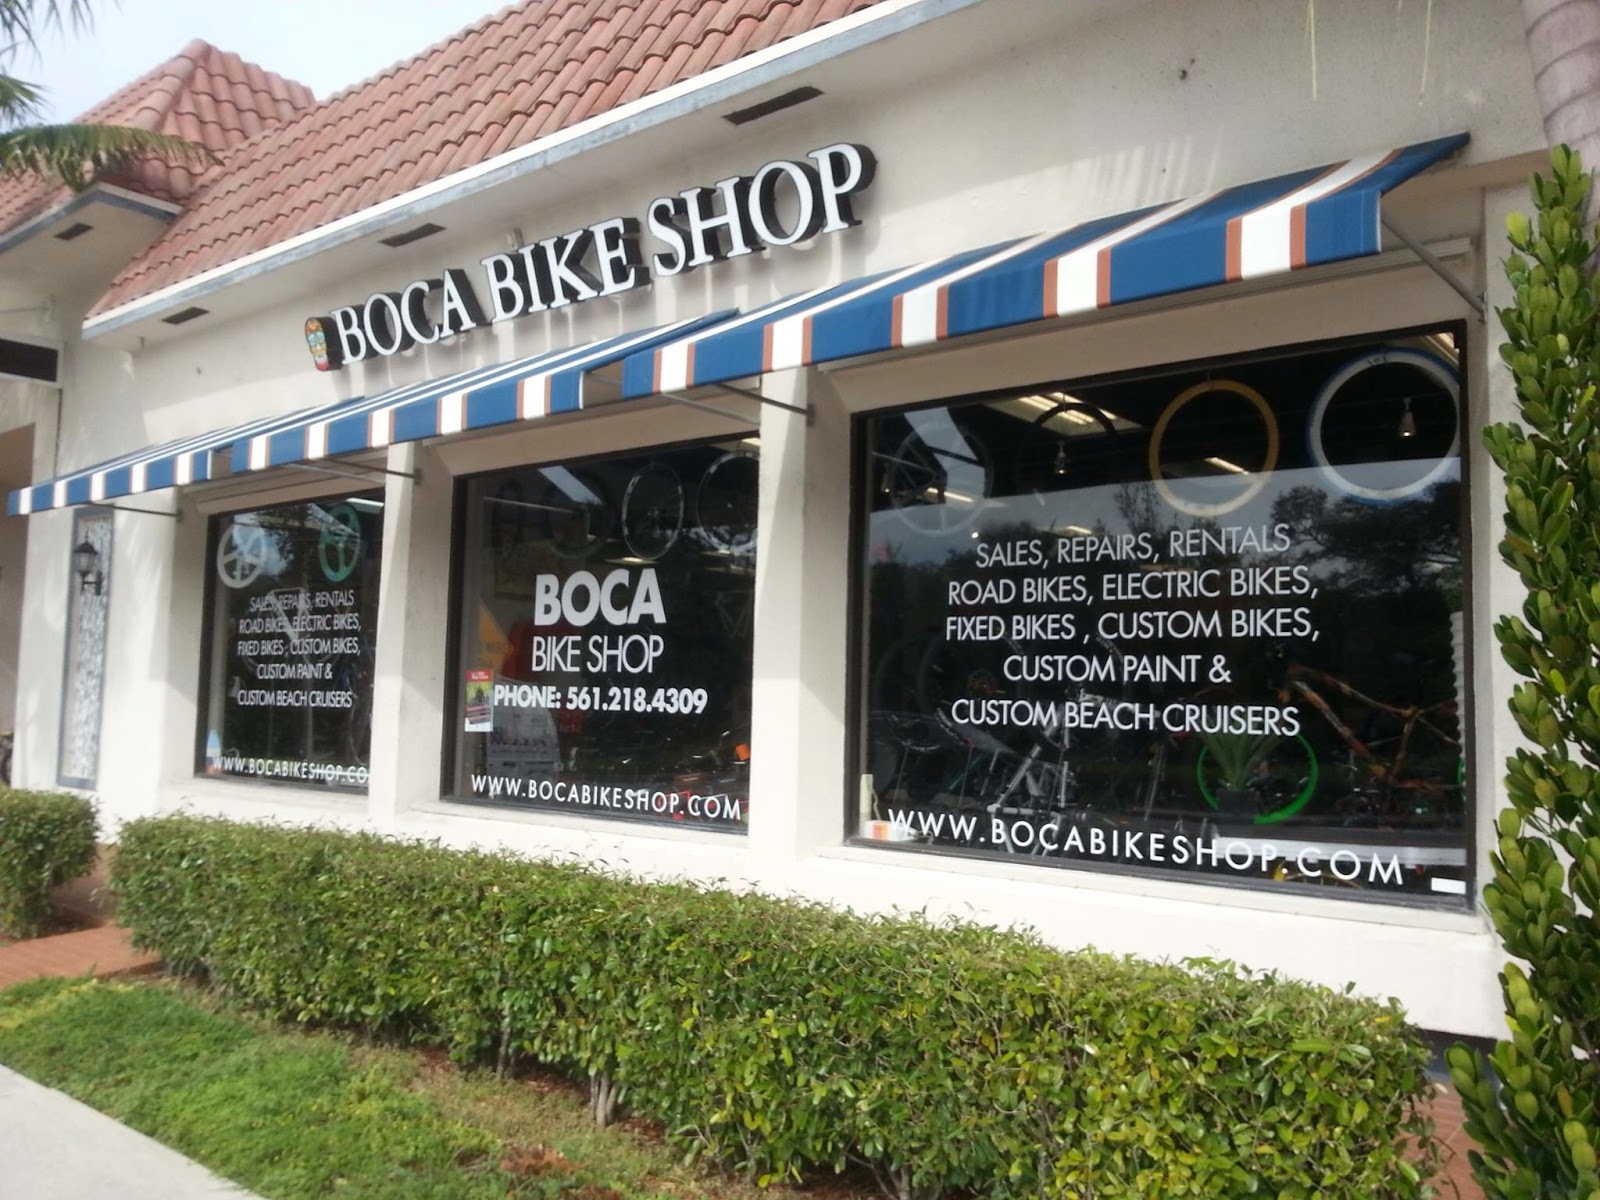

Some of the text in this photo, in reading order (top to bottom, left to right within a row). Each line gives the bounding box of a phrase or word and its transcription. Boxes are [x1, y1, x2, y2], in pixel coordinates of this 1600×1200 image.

[329, 143, 870, 364] BOCA BIKE SHOP
[975, 523, 1292, 570] SALES, REPAIRS, RENTALS
[280, 593, 314, 611] REPAS,
[315, 589, 355, 608] RENTALS
[534, 568, 667, 627] BOCA
[948, 565, 1320, 606] ROAD BIKES, ELECTRIC BIKES,
[239, 618, 265, 634] ROAD
[292, 614, 332, 632] ELECTRIC
[333, 613, 362, 632] BIKES,
[946, 615, 1006, 641] FIXED
[1097, 610, 1222, 640] CUSTOM
[1230, 607, 1321, 643] BIKES,
[238, 640, 260, 656] FIXED
[290, 638, 332, 655] CUSTOM
[332, 637, 361, 656] BIKES,
[532, 634, 665, 674] BIKE SHOP
[257, 662, 333, 679] CUSTOM PAINT &
[1003, 654, 1232, 684] CUSTOM PAINT &
[238, 689, 353, 708] CUSTOM BEACH CRUISERS
[493, 684, 709, 715] PHONE: 561.218.4309
[951, 698, 1300, 737] CUSTOM BEACH CRUISERS
[213, 756, 369, 783] WWW.BOCABIKESHOP.CO
[471, 773, 742, 821] WWW.BOCABIKESHOP.COM
[887, 808, 1403, 886] WWW.BOCABIKESHOP.COM
